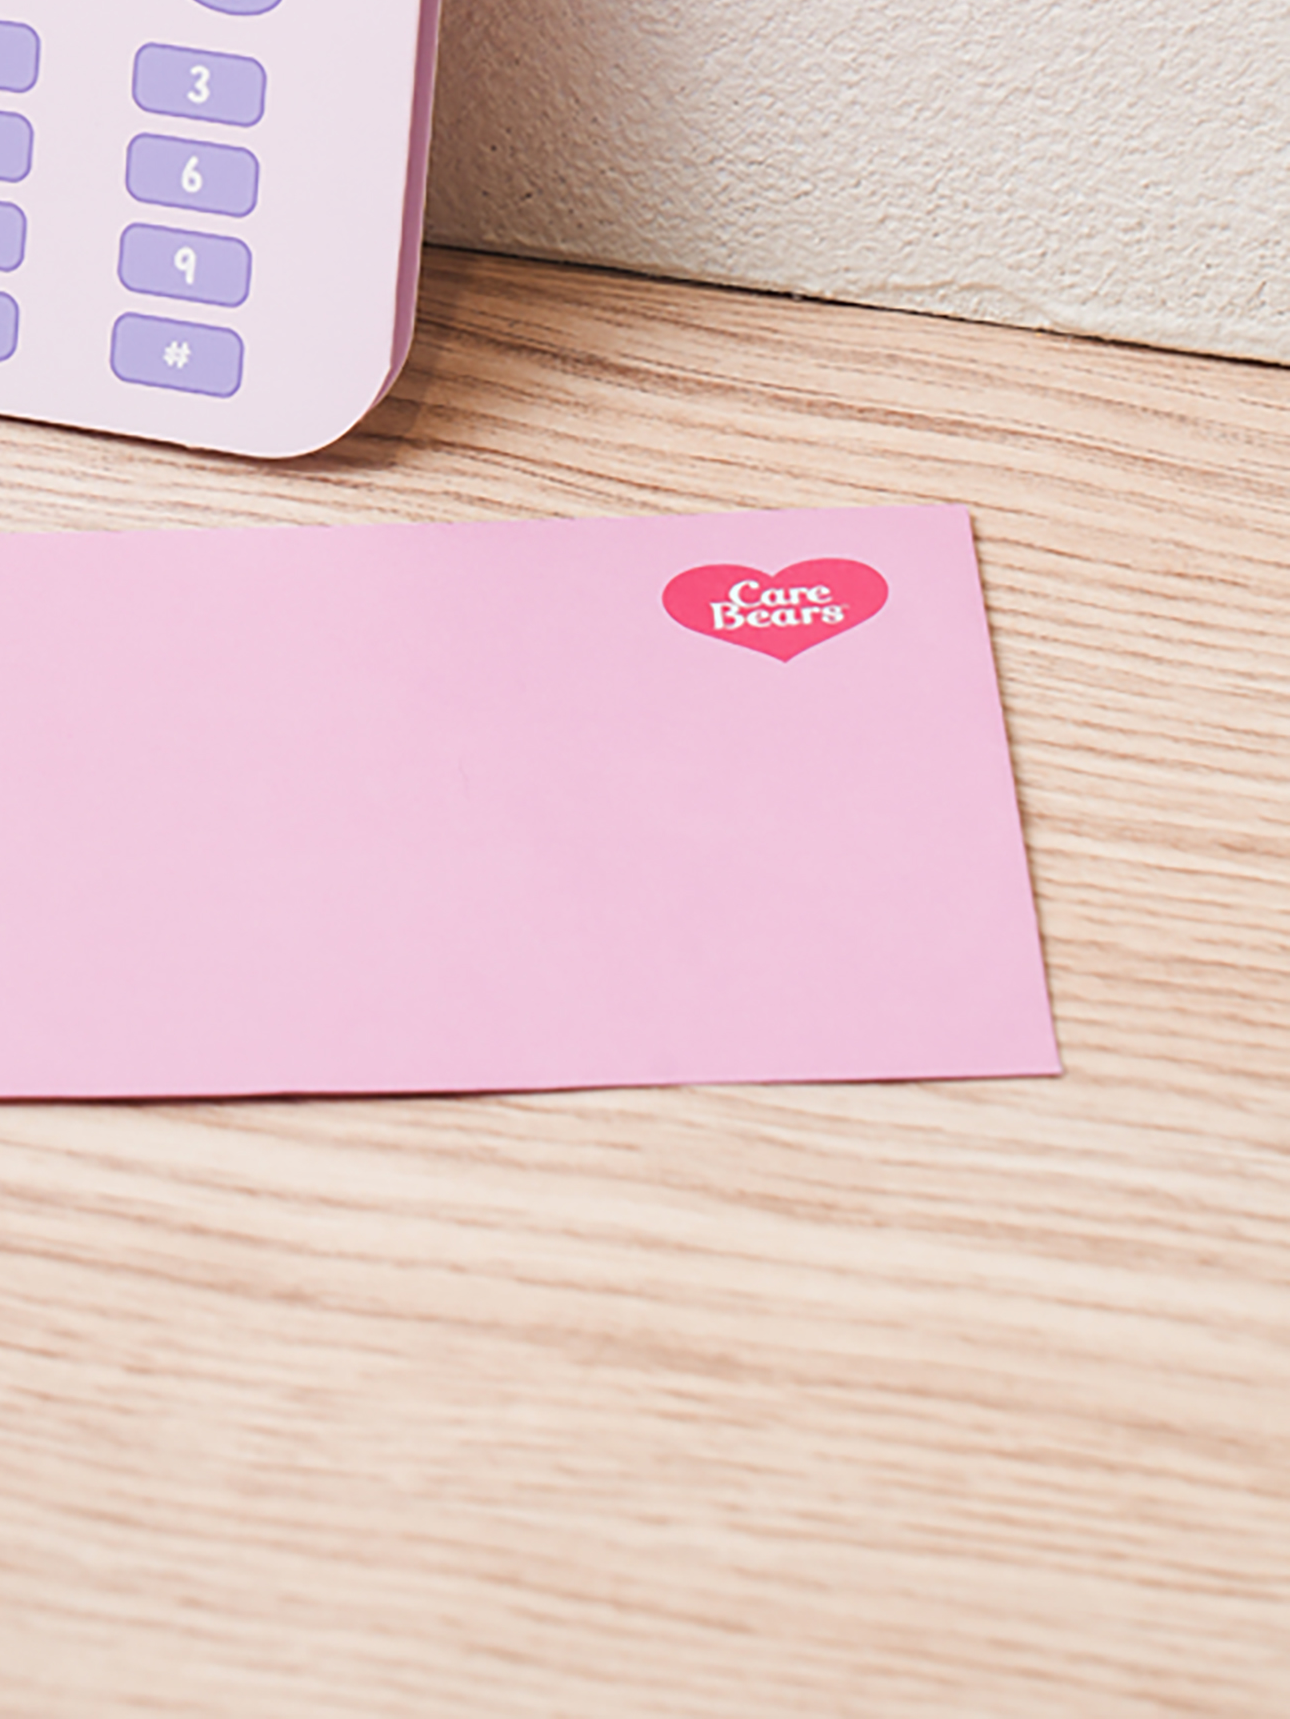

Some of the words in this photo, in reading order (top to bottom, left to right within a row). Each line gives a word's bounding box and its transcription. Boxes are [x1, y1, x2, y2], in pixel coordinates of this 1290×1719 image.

[187, 65, 210, 104] 3
[181, 155, 203, 193] 6
[174, 246, 197, 285] 9
[728, 579, 832, 608] Care
[710, 601, 845, 630] Bears
